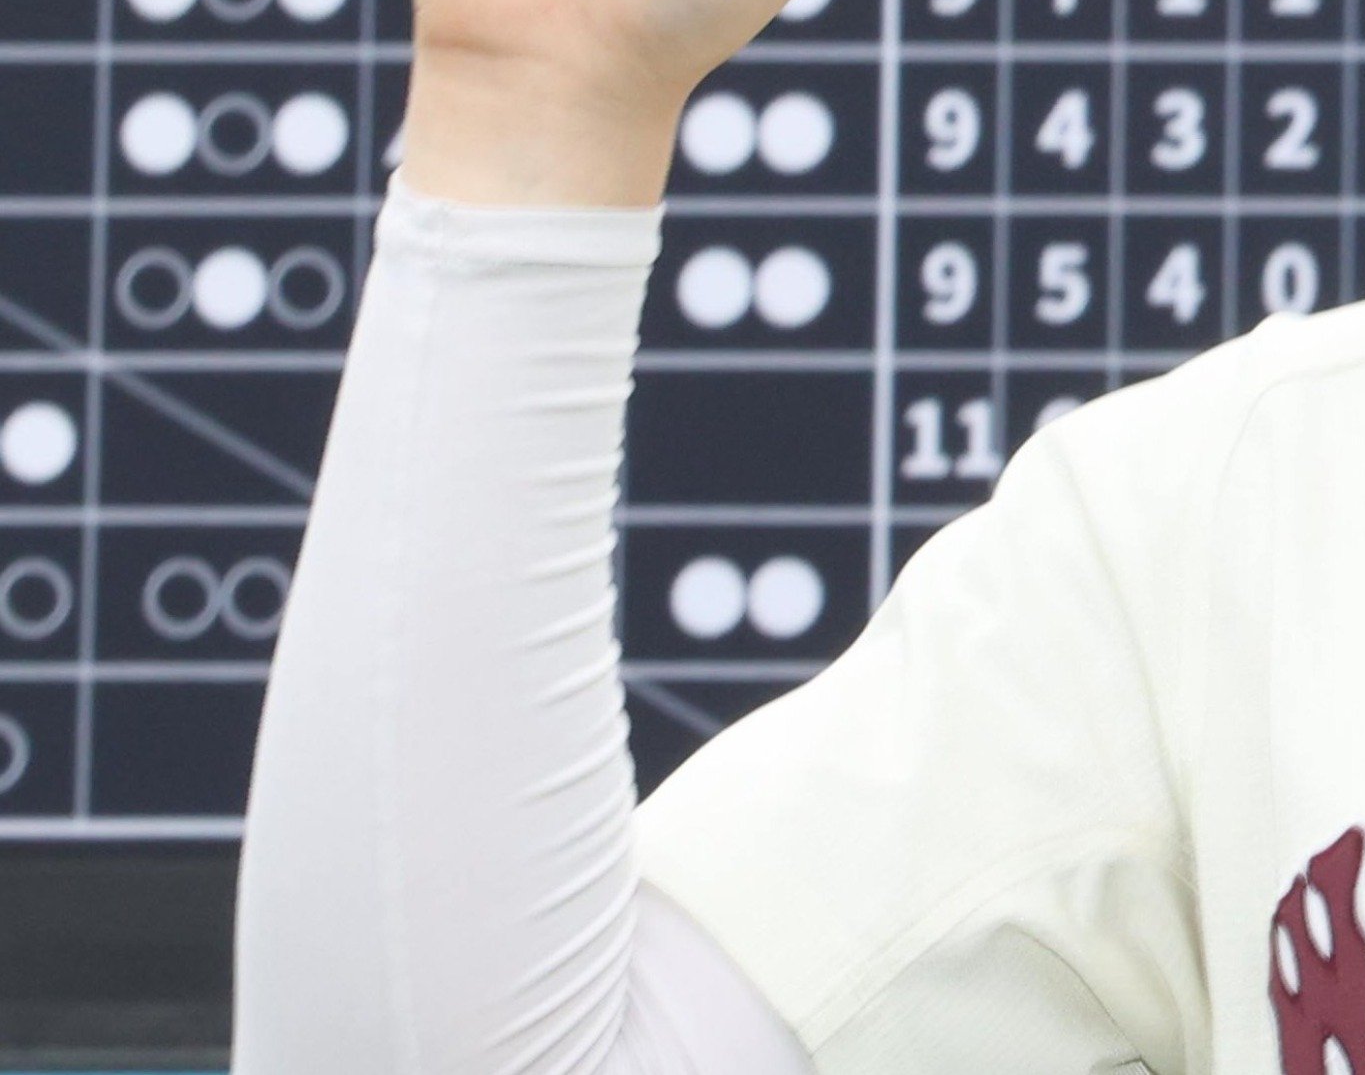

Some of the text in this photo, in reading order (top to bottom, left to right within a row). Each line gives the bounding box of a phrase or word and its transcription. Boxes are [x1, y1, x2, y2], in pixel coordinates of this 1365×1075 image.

[924, 88, 981, 170] 9
[1035, 89, 1095, 169] 4
[1151, 88, 1206, 170] 3
[1264, 88, 1319, 170] 2
[920, 242, 978, 324] 9
[1036, 243, 1091, 325] 5
[1146, 243, 1204, 323] 4
[1261, 242, 1320, 317] 0
[901, 398, 999, 480] 11
